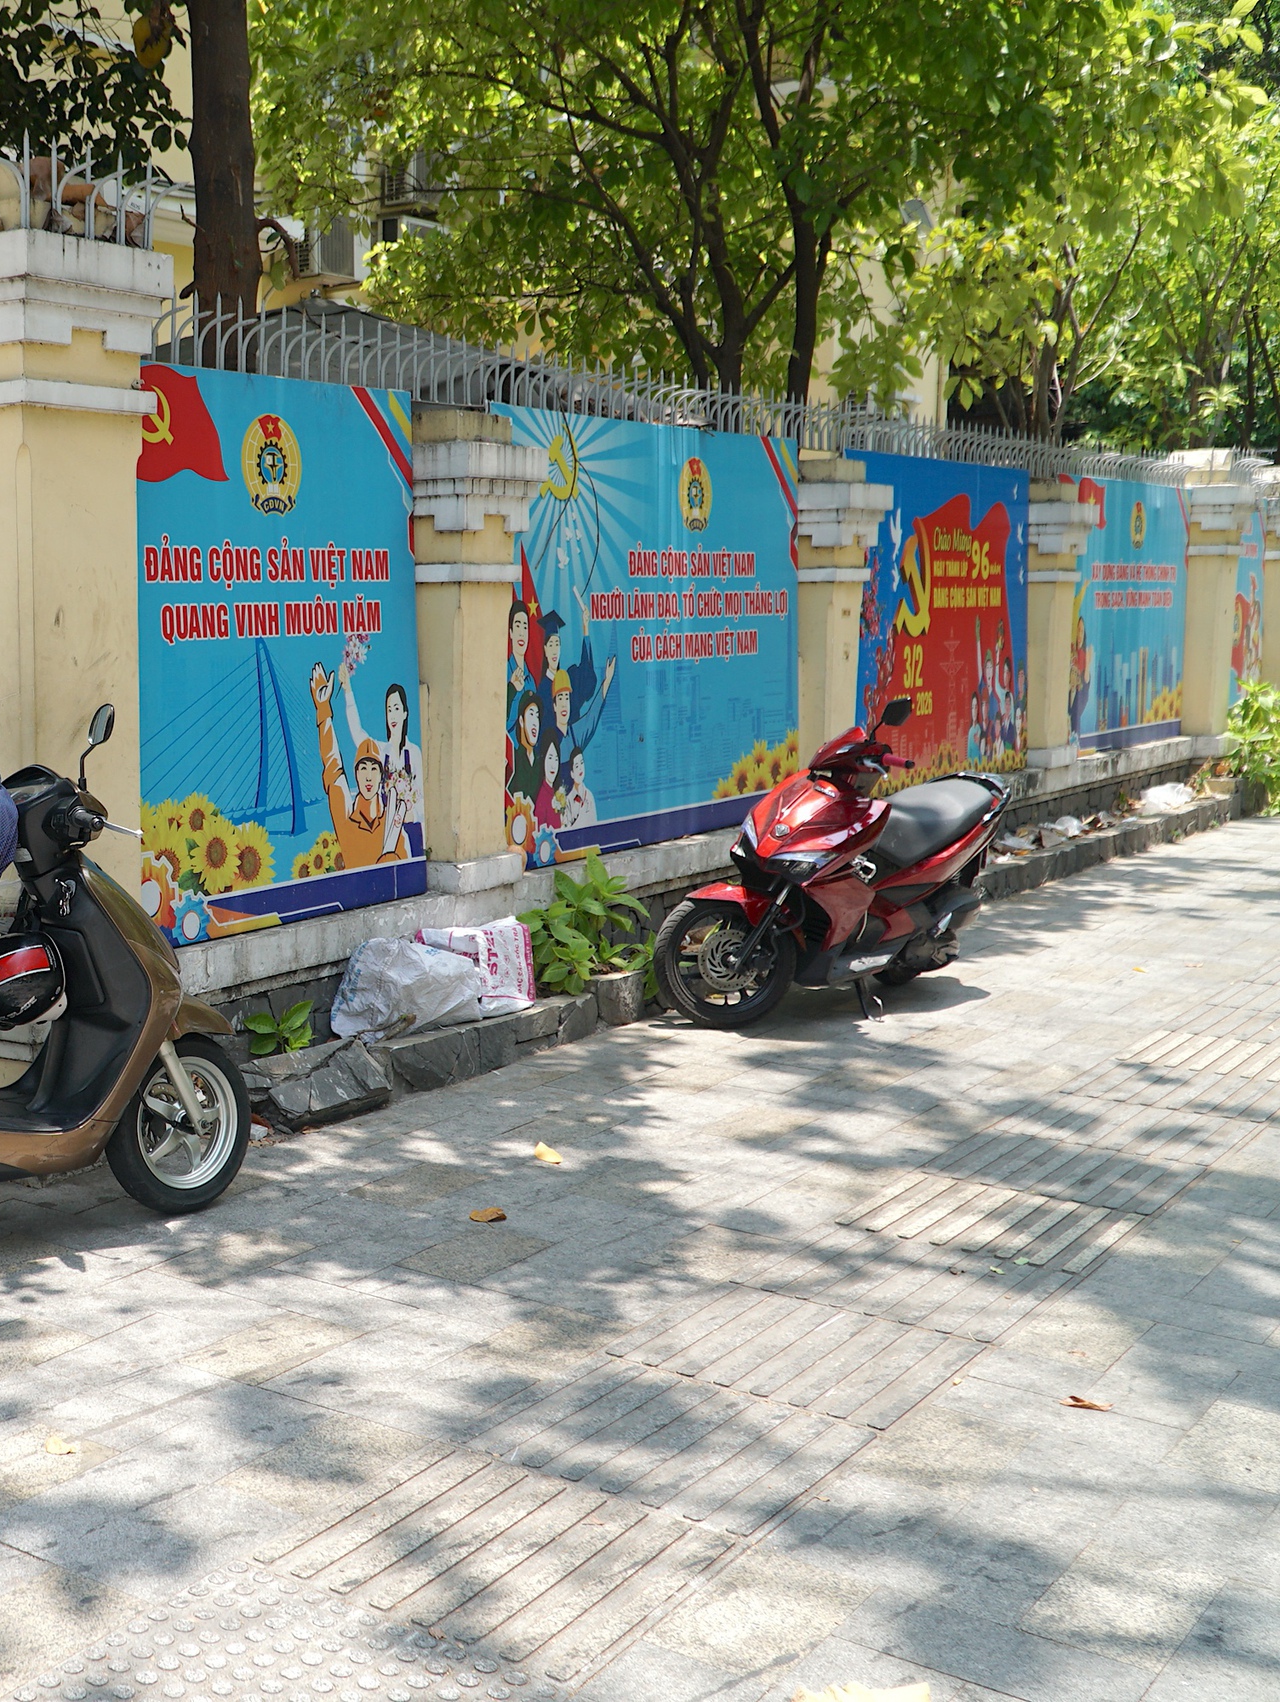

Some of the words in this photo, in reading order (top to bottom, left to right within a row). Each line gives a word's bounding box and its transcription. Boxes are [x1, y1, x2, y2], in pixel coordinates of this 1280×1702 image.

[144, 533, 202, 582] ĐẢNG
[208, 541, 262, 590] CỘNG
[267, 536, 305, 582] SẢN
[310, 543, 346, 591] VIỆT
[351, 548, 390, 582] NAM
[628, 541, 658, 577] ĐẢNG
[660, 545, 688, 583] CỘNG
[690, 543, 710, 577] SẢN
[712, 547, 733, 583] VIỆT
[734, 552, 755, 577] NAM
[972, 541, 990, 580] 96
[161, 602, 229, 645] QUANG
[234, 602, 279, 637] VINH
[285, 595, 338, 636] MUÔN
[342, 593, 382, 633] NĂM
[590, 586, 625, 621] NGƯỜI
[627, 588, 655, 620] LÃNH
[657, 592, 681, 624] ĐẠO,
[697, 587, 723, 618] CHỨC
[724, 593, 743, 621] MỌI
[744, 582, 773, 616] THẮNG
[774, 588, 789, 620] LỢI
[631, 626, 653, 663] CỦA
[654, 628, 683, 660] CÁCH
[684, 632, 714, 664] MẠNG
[715, 626, 735, 662] VIỆT
[736, 629, 758, 655] NAM
[903, 644, 923, 689] 3/2
[916, 691, 933, 716] 2026
